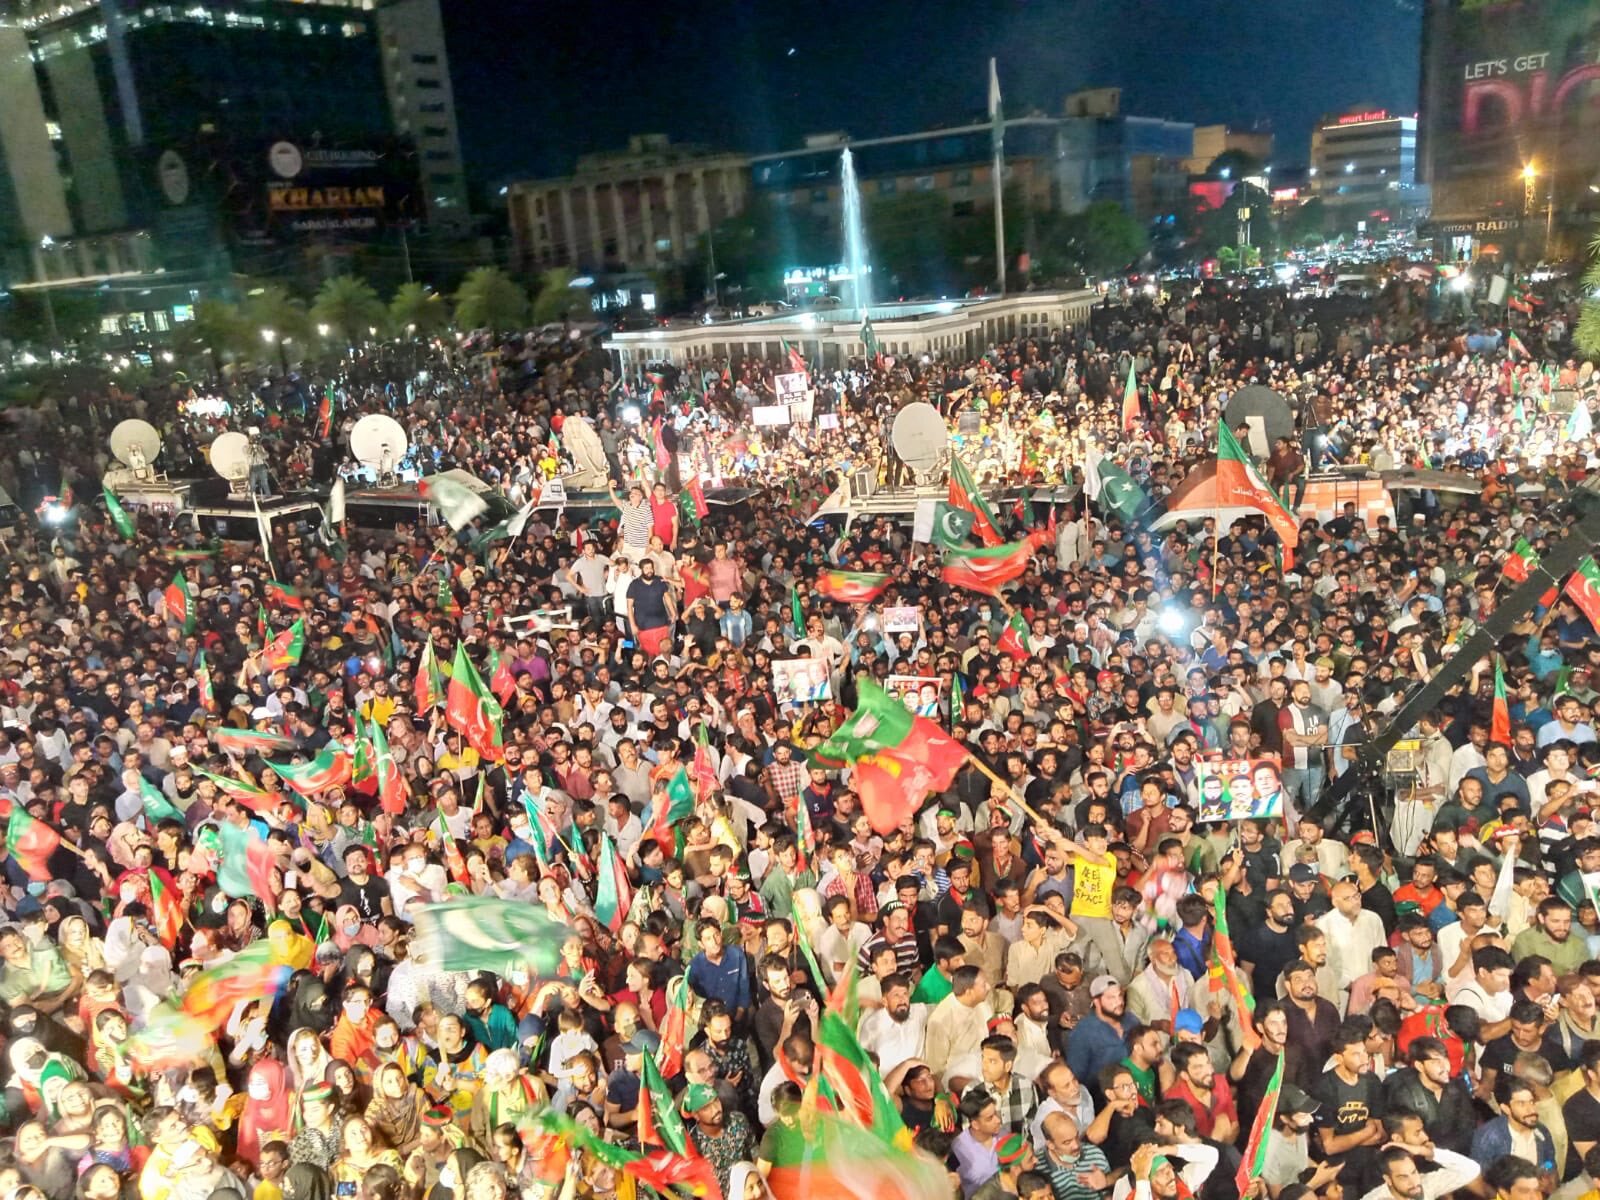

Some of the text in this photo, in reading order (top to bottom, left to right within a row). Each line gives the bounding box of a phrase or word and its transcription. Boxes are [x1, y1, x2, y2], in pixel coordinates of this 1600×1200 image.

[1464, 52, 1550, 80] LET'S GET
[1475, 220, 1520, 232] RADO
